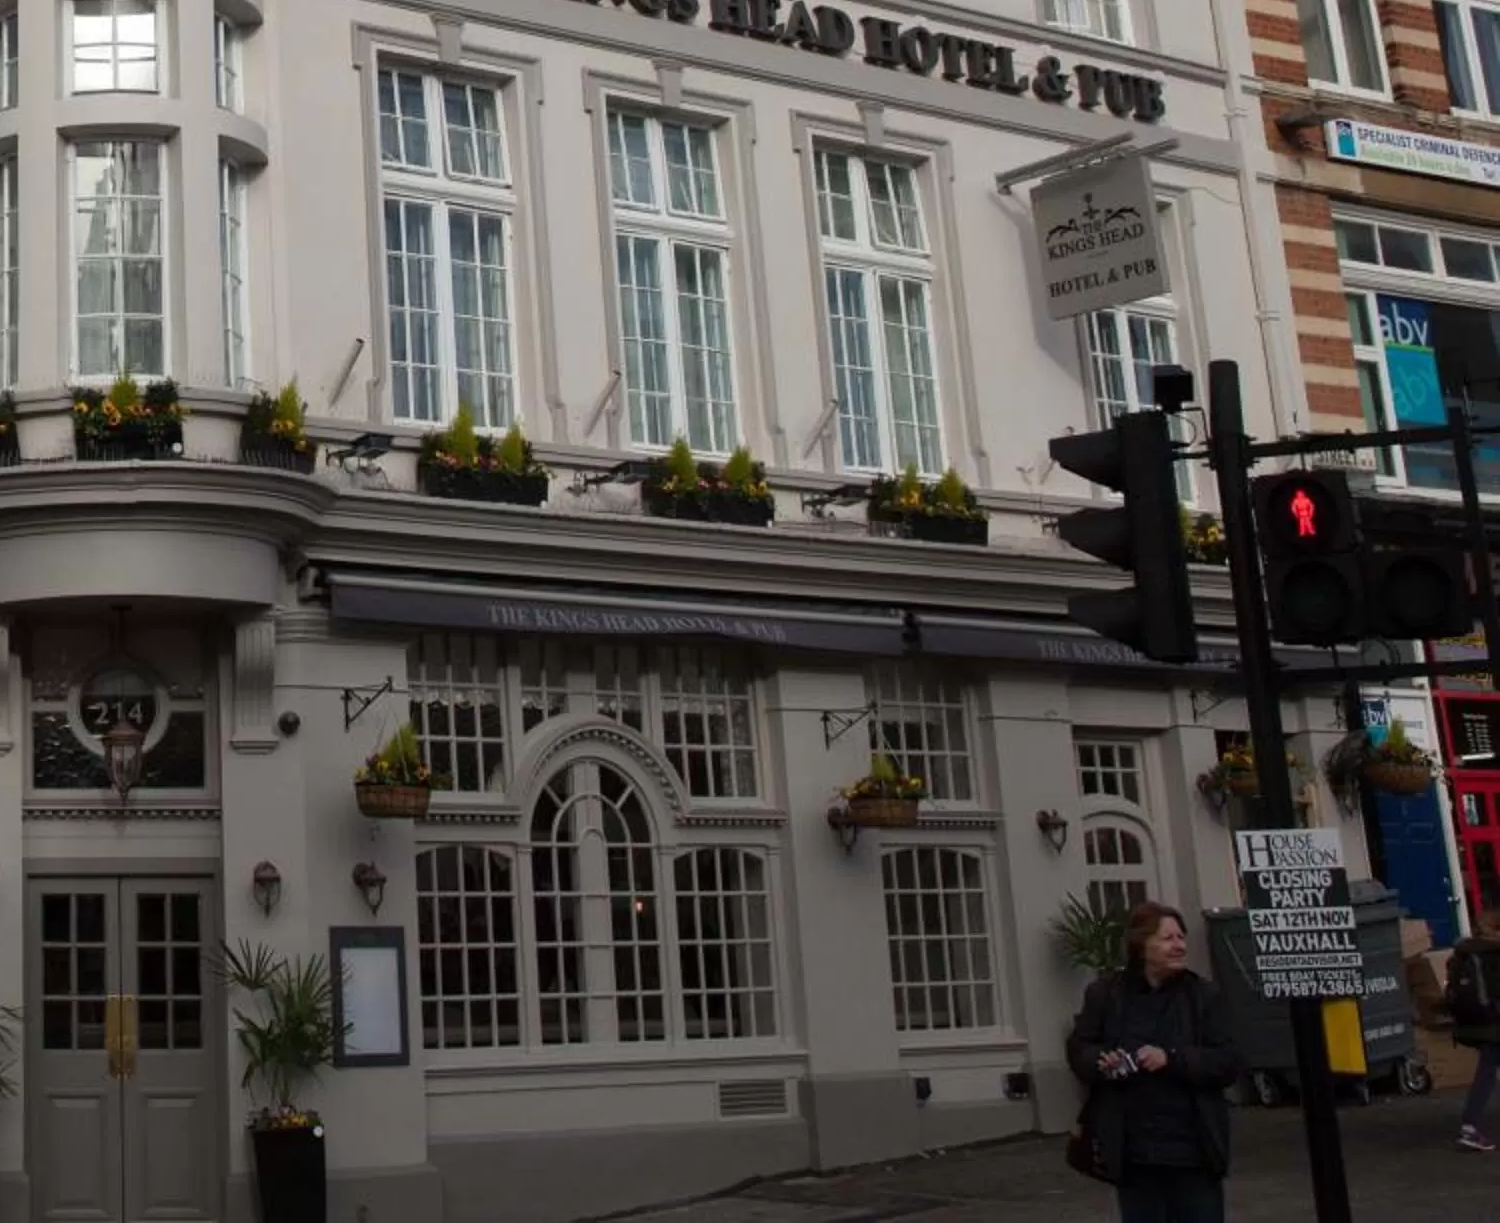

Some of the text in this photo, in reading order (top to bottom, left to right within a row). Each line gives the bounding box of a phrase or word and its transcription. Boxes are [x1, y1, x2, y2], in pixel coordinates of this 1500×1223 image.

[859, 15, 1028, 96] HOTEL
[1032, 55, 1072, 103] &
[1073, 64, 1165, 123] PUB
[1357, 127, 1411, 148] SPECIALIST
[1413, 137, 1460, 158] CRIMINAL
[1461, 145, 1500, 166] DEFENC
[1048, 223, 1145, 260] KINGS HEAD
[1048, 259, 1157, 298] HOTEL & PUB
[486, 603, 526, 626] THE
[534, 608, 599, 630] KINGS
[601, 613, 659, 632] HEAD
[661, 616, 725, 634] HOTEL
[749, 621, 787, 642] PUB
[1037, 639, 1067, 659] THE
[1070, 644, 1119, 663] KINGS
[93, 700, 143, 725] 214
[1274, 848, 1337, 866] PASSION
[1258, 870, 1332, 889] CLOSING
[1269, 888, 1325, 907] PARTY
[1252, 911, 1350, 928] SAT 12TH NOV
[1256, 932, 1356, 953] VAUXHALL
